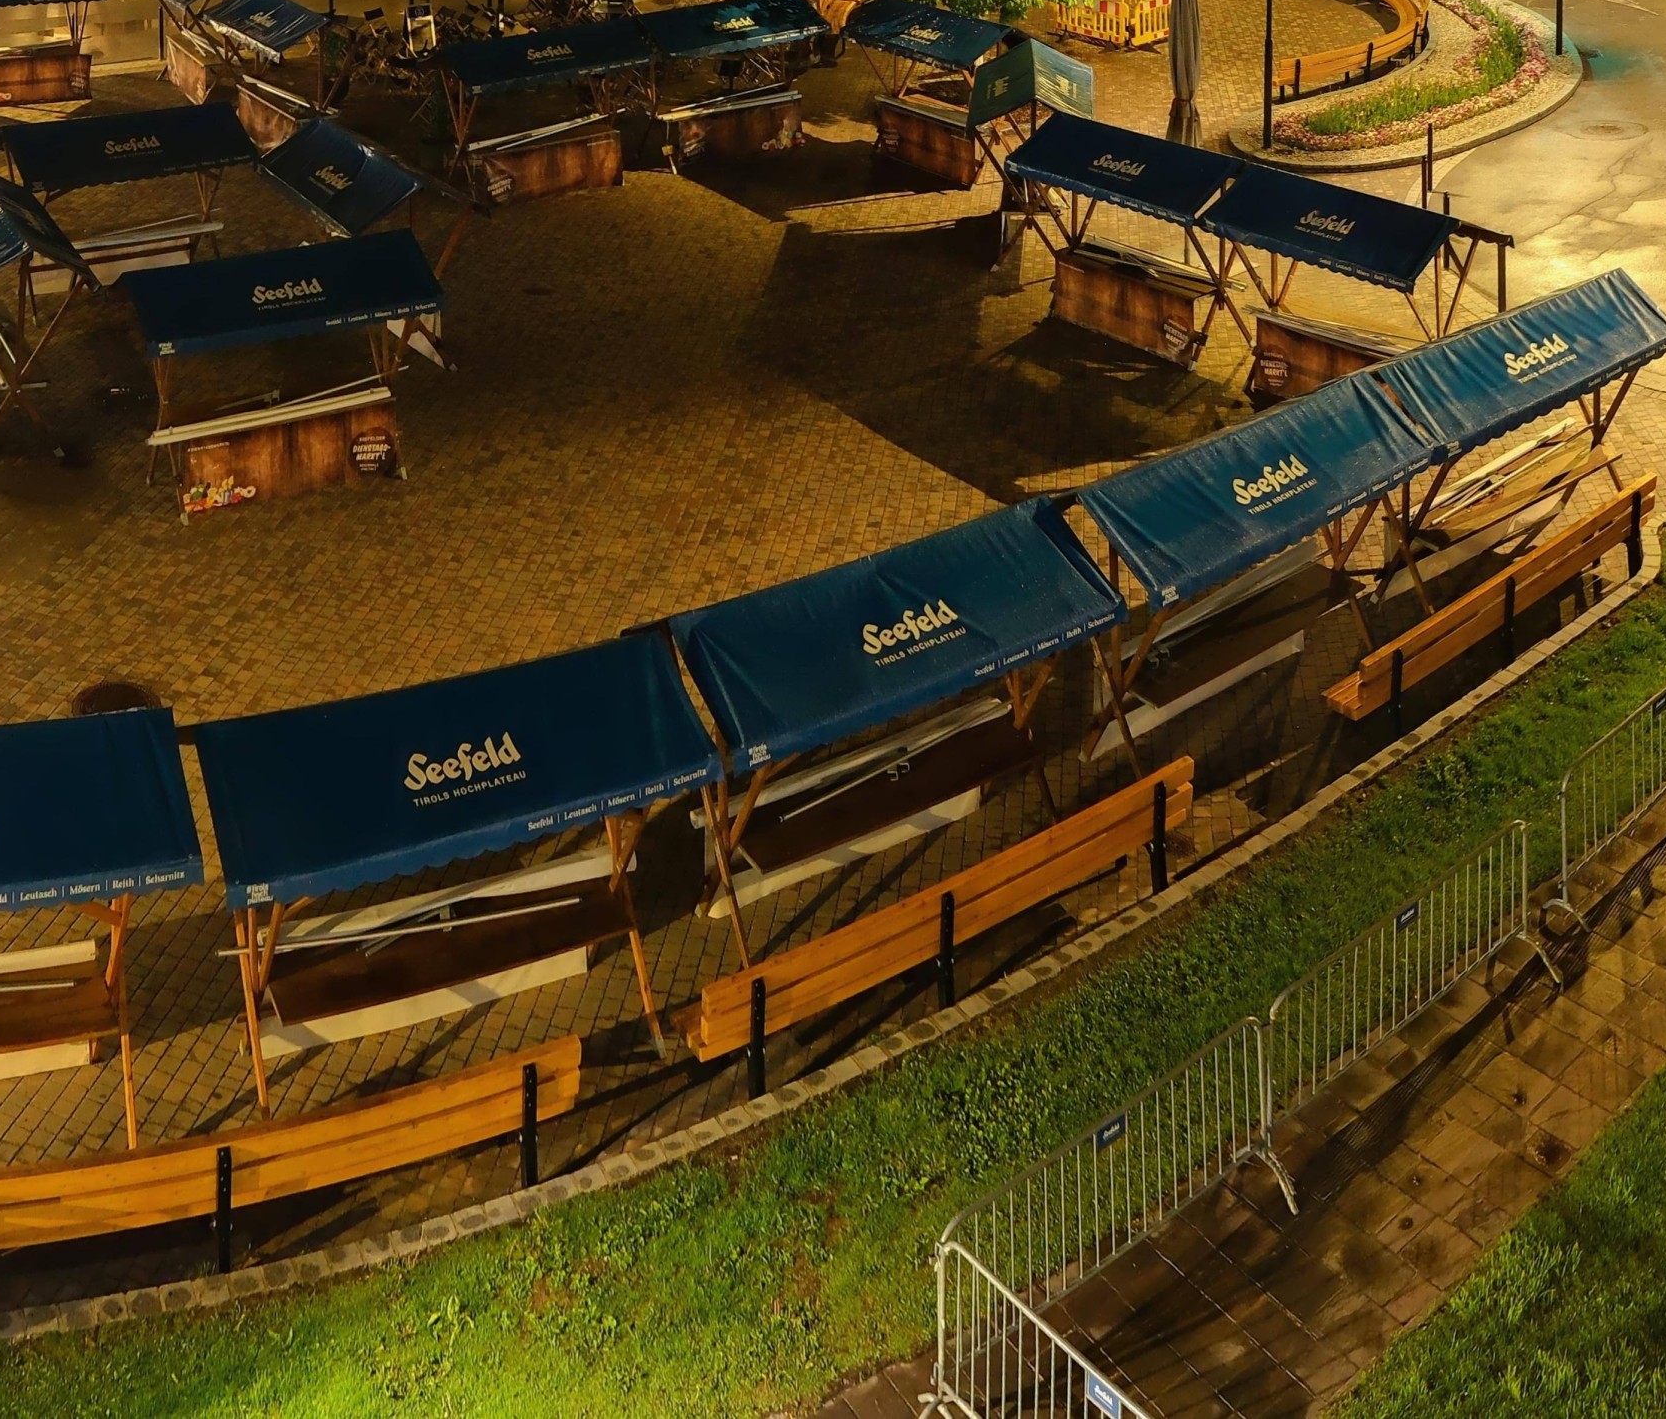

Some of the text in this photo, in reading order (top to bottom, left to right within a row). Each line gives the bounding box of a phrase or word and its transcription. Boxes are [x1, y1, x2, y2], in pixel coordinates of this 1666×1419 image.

[252, 278, 323, 304] Seefeld
[1504, 334, 1569, 375] Seefeld
[1232, 455, 1309, 505] Seefeld
[861, 598, 959, 655] Seefeld
[874, 626, 967, 669] TIROLS HOCHPLATEAU
[404, 732, 521, 790] Seefeld
[412, 769, 527, 809] TIROLS HOCHPLATEAU
[527, 817, 555, 833] Seefeld
[562, 804, 598, 823] Leutasch
[19, 887, 58, 902] Leutasch
[112, 878, 135, 891] Reith
[144, 871, 185, 887] Scharnitz
